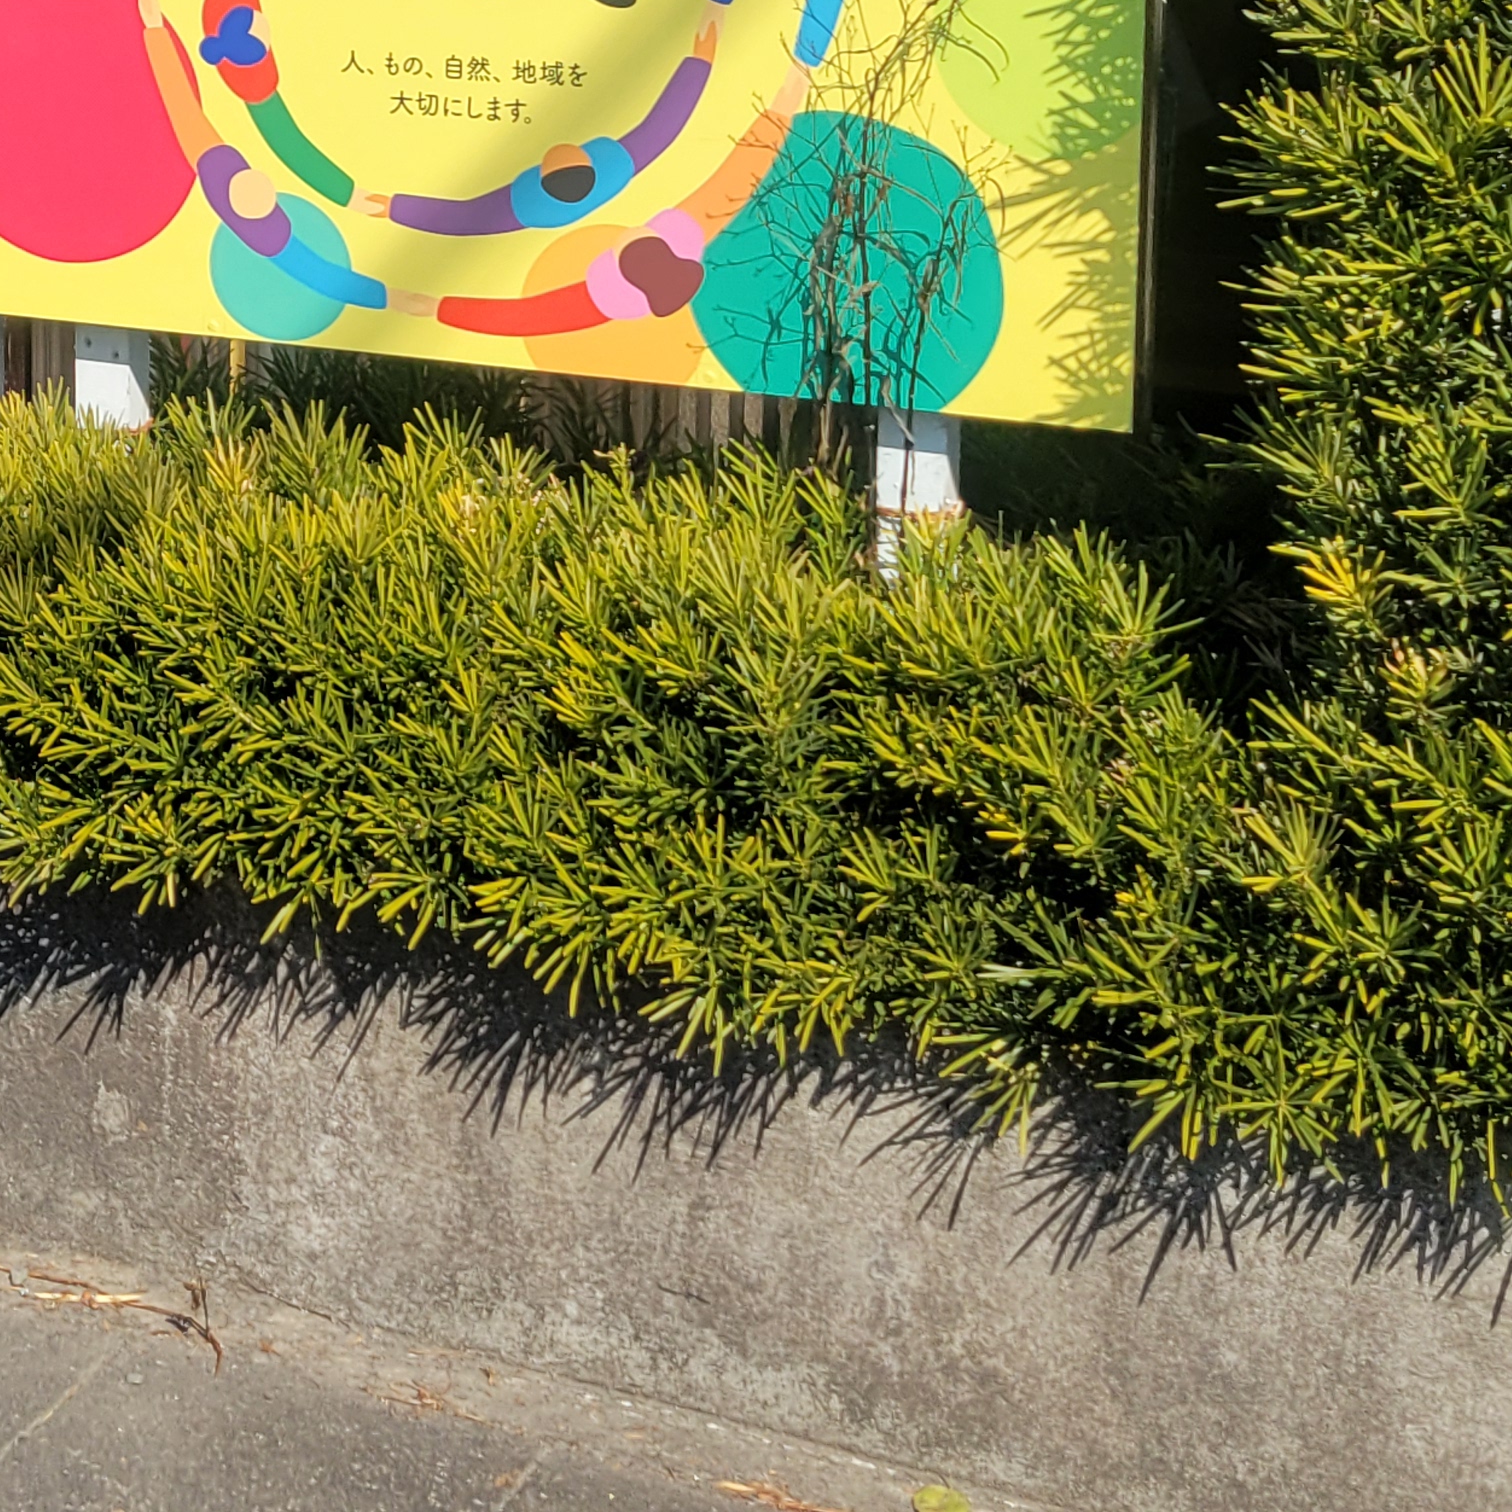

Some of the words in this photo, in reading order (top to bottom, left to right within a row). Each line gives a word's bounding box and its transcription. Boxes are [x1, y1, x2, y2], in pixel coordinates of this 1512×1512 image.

[341, 50, 588, 88] 人、もの、自然、地域を
[389, 90, 533, 126] 大切にします。
